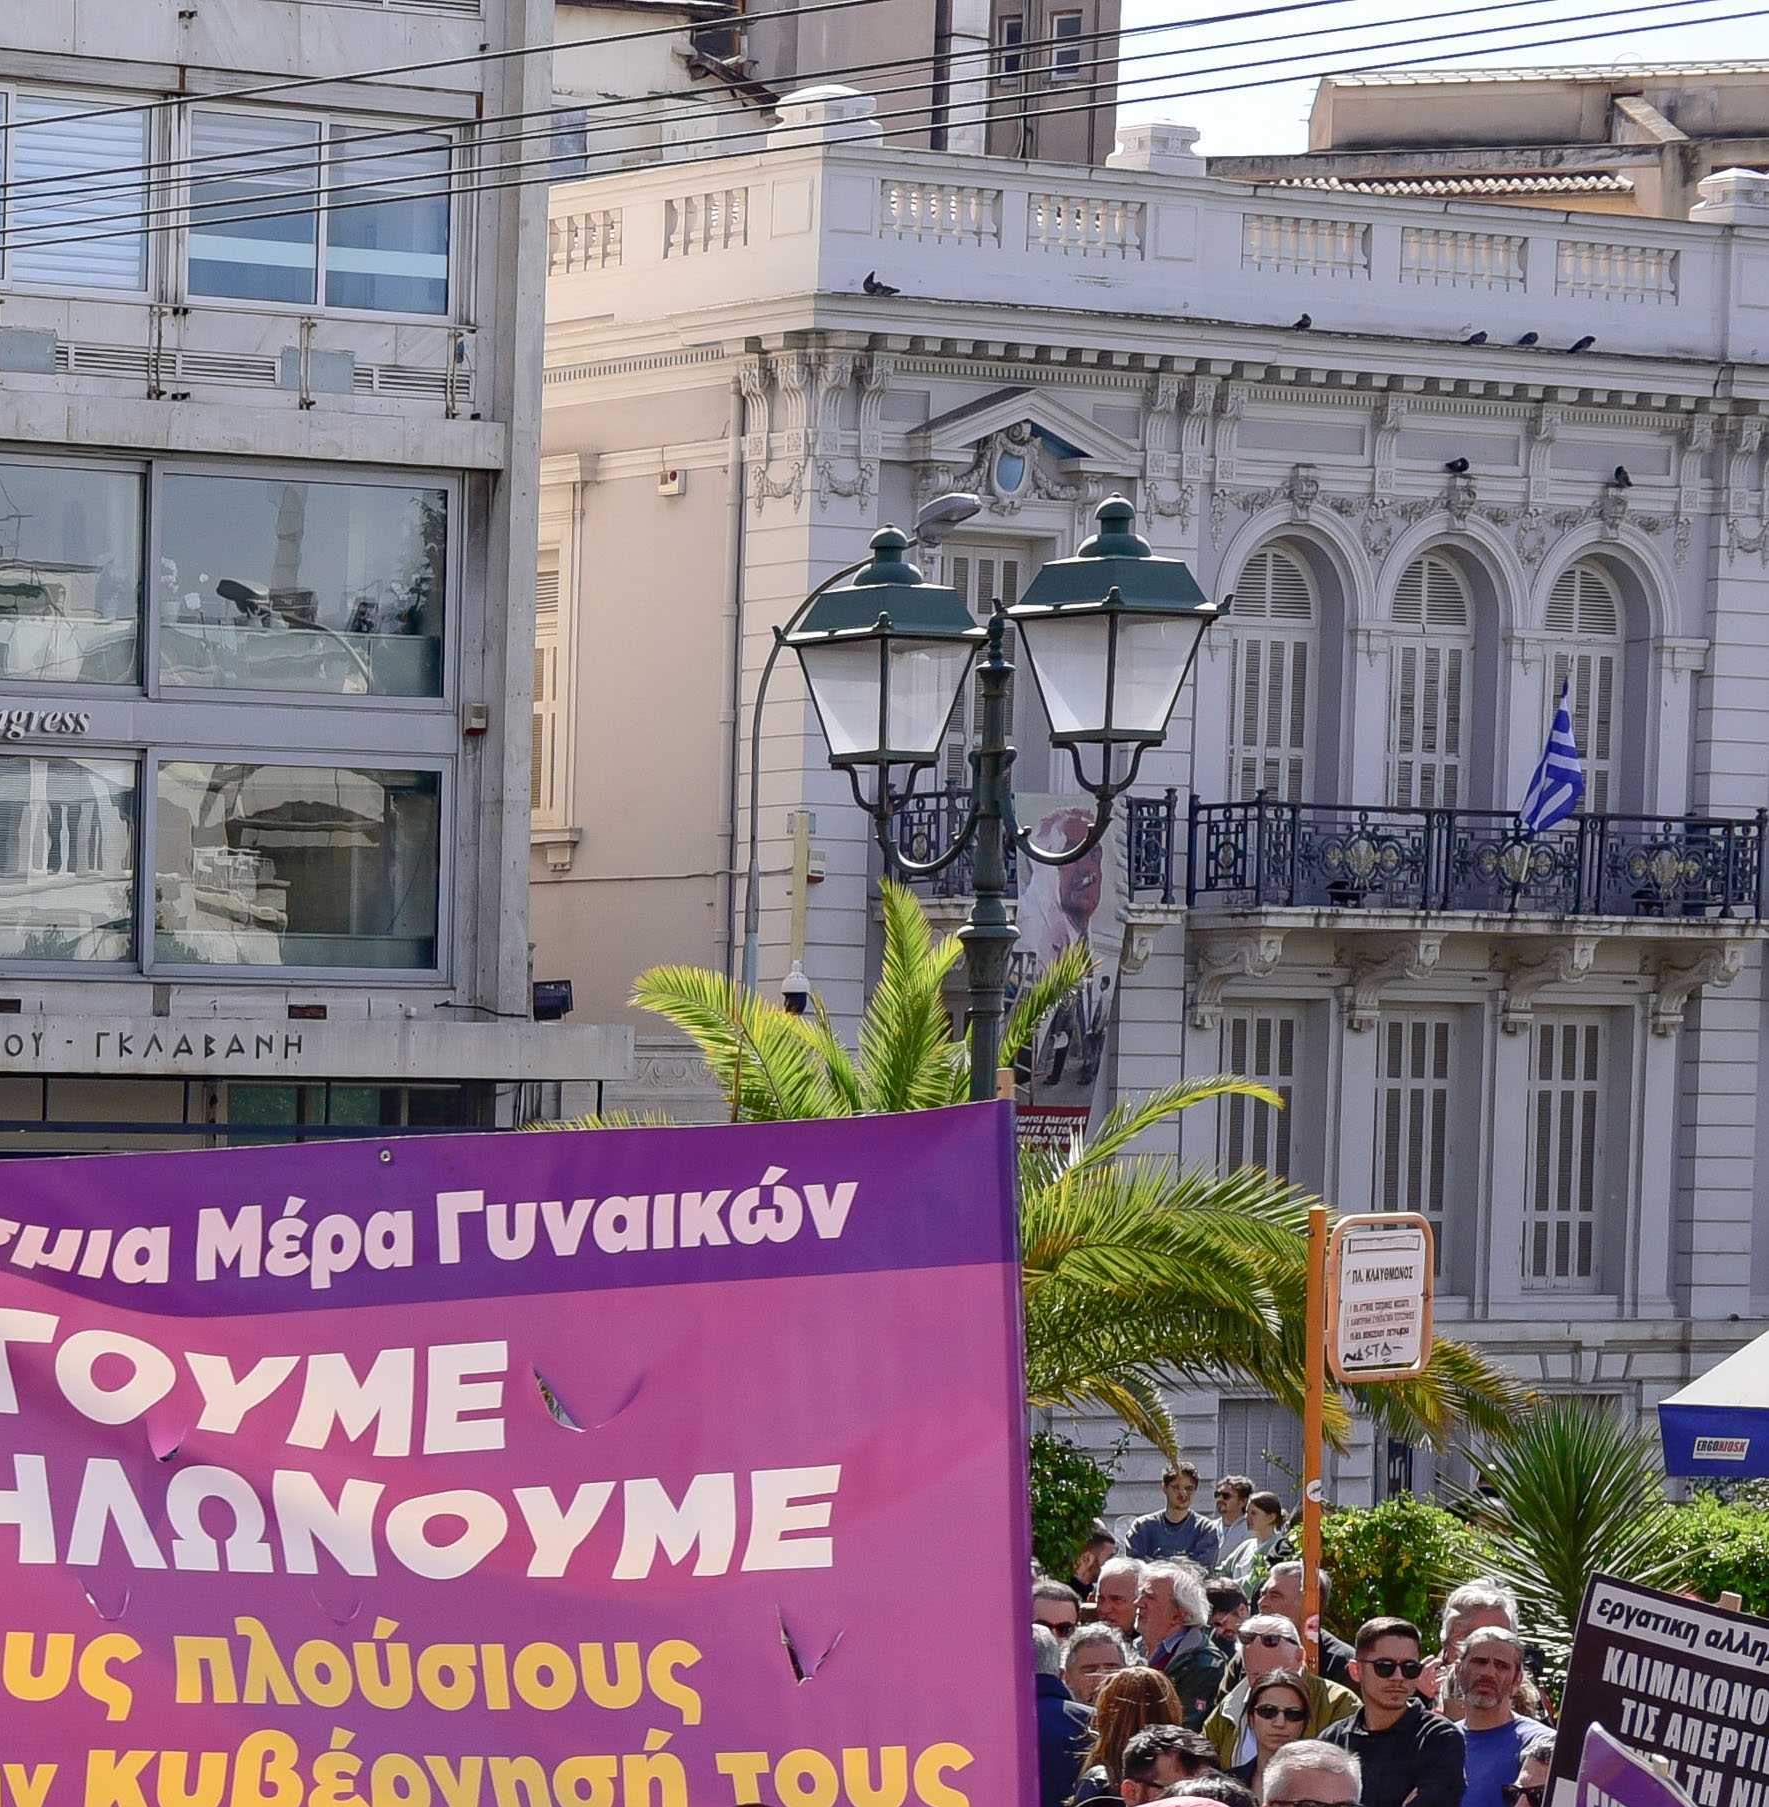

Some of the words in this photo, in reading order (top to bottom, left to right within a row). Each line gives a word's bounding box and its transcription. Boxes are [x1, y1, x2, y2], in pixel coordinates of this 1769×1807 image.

[94, 1029, 306, 1062] ΓΚΛΑΒΑΝΗ
[195, 1197, 414, 1290] Μέρα
[435, 1165, 860, 1265] Γυναικών
[1696, 1440, 1747, 1453] ERGOKIOSK
[172, 1616, 704, 1727] πλούσιους
[1619, 1697, 1660, 1744] ΤΙΣ
